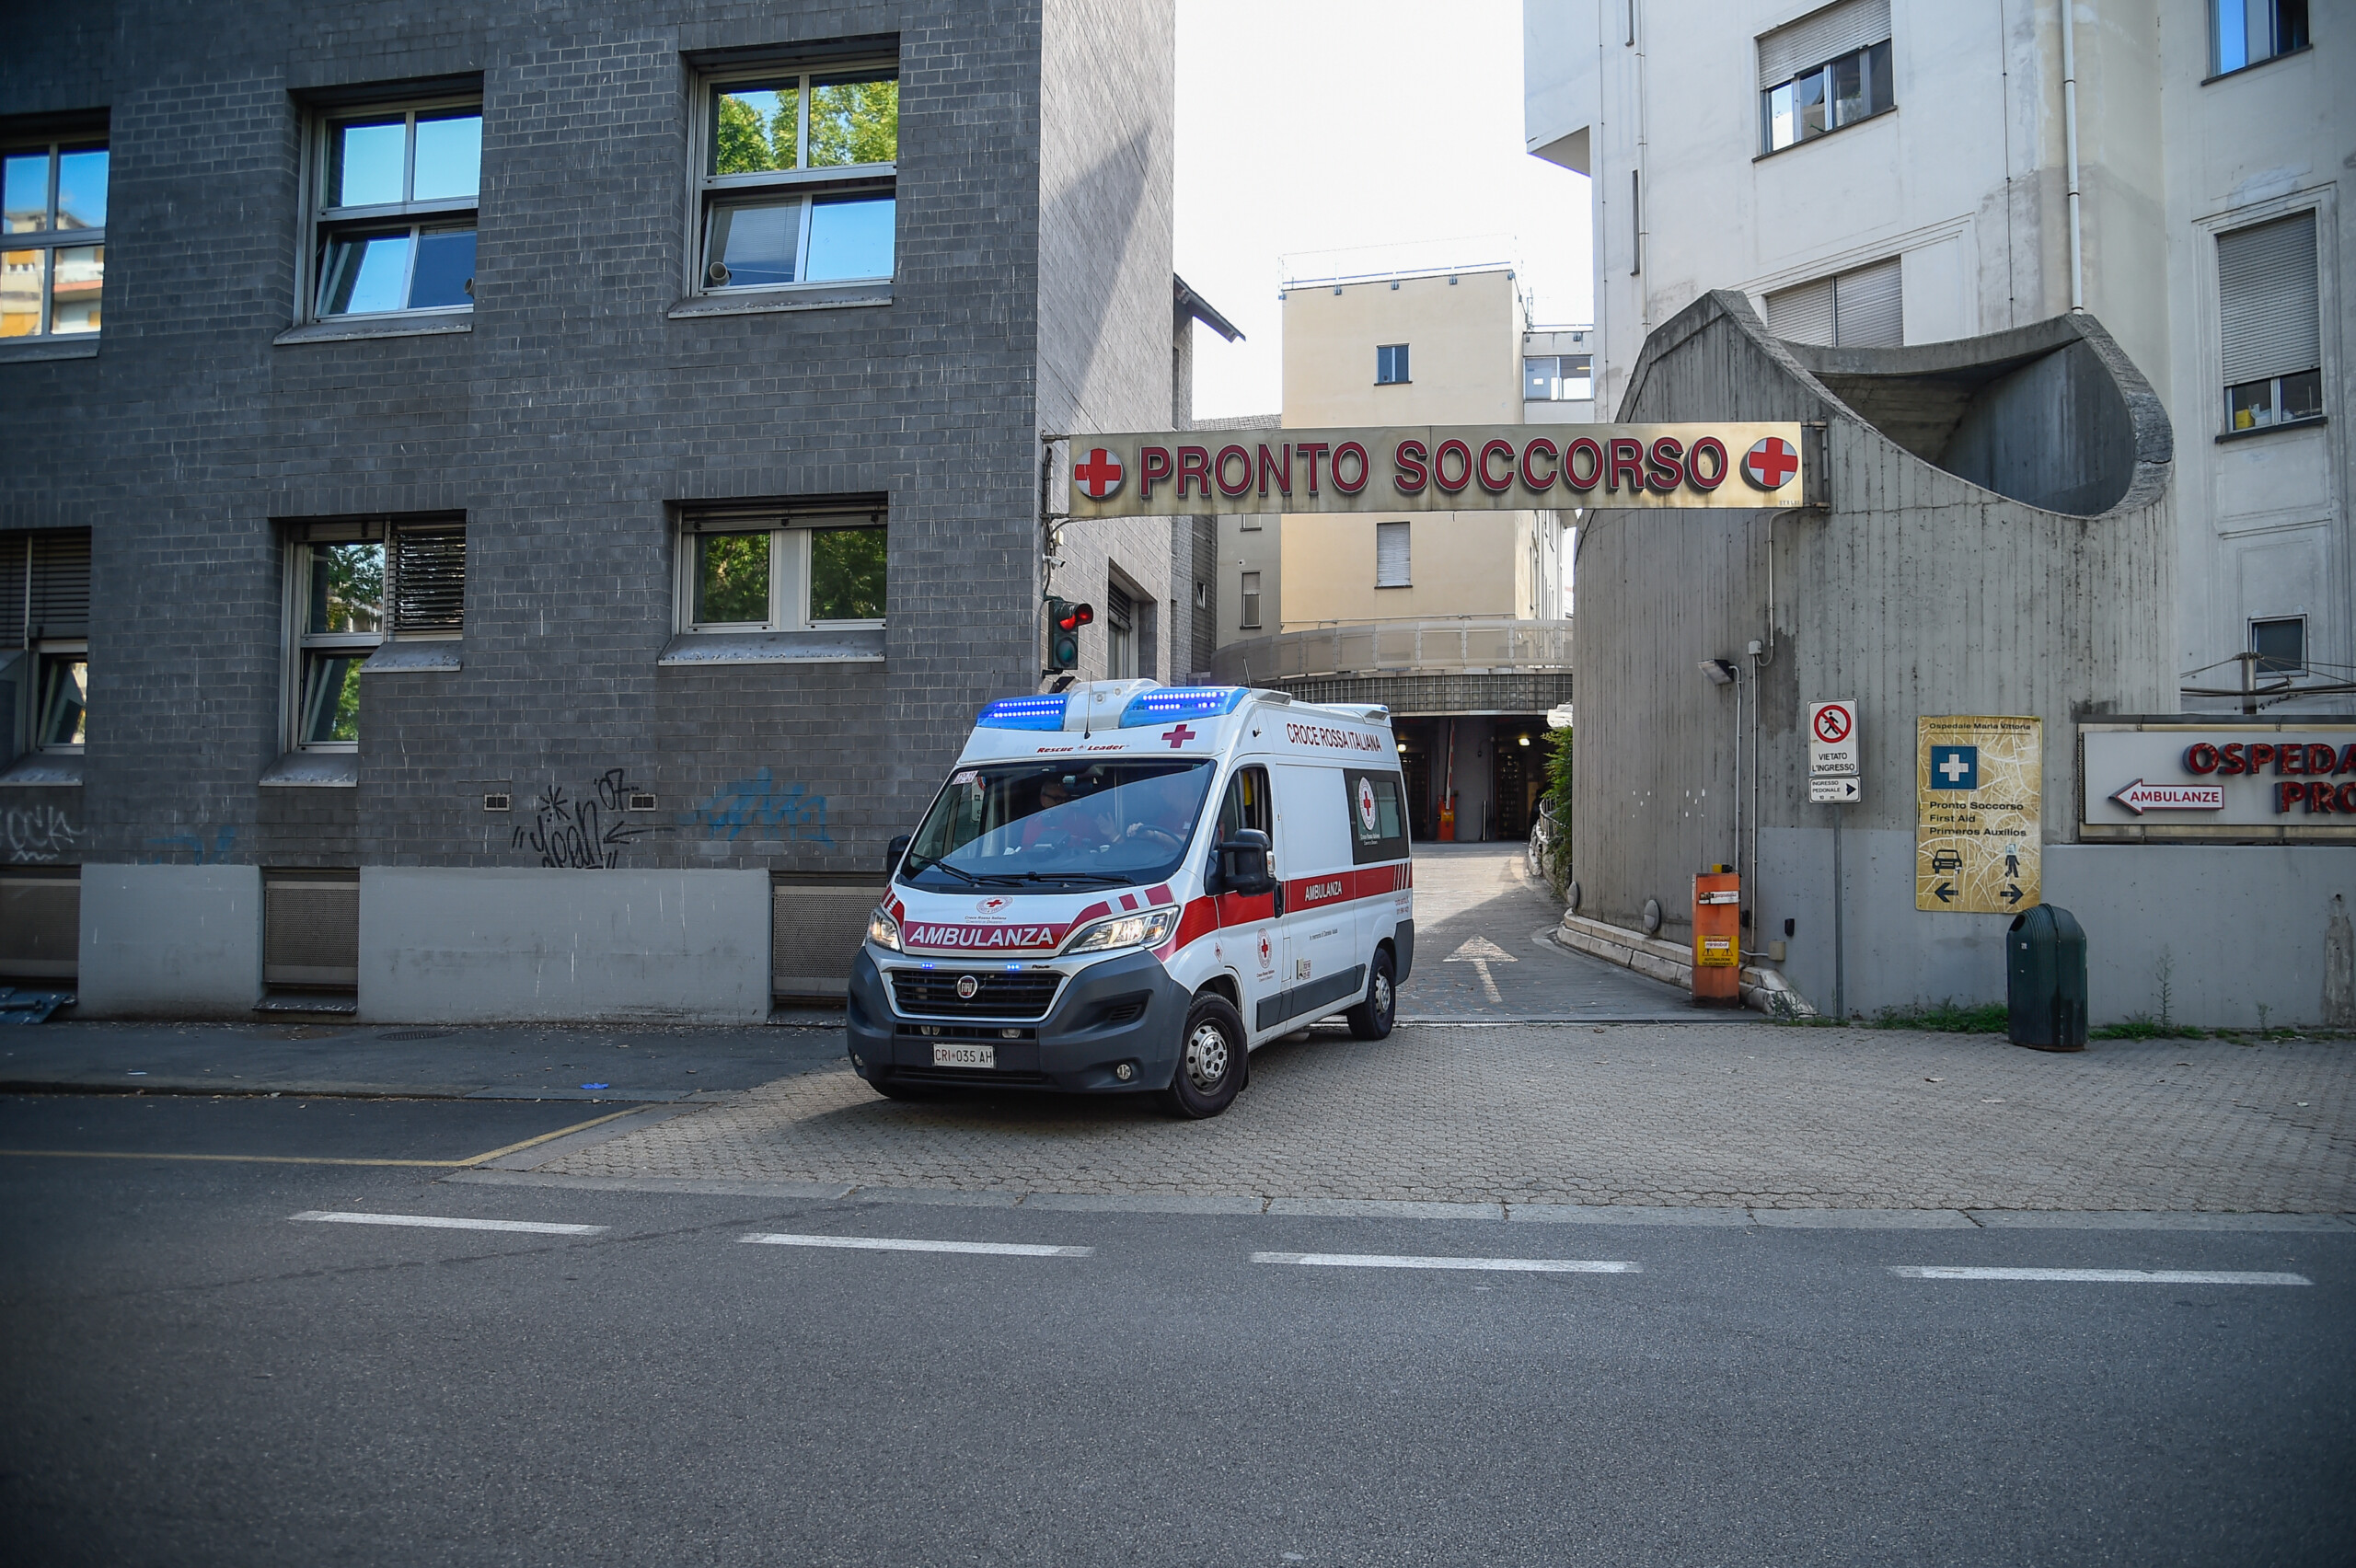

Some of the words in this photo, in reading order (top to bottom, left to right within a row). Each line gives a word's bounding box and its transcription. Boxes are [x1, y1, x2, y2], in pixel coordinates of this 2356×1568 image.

[1139, 440, 1371, 500] PRONTO
[1393, 435, 1729, 493] SOCCORSO
[1929, 722, 1971, 731] Ospedale
[2000, 722, 2031, 731] Vittoria
[1286, 722, 1321, 746] CROCE
[1319, 727, 1350, 749] ROSSA
[1347, 731, 1383, 753] ITALIANA
[1818, 752, 1848, 761] VIETATO
[1811, 763, 1855, 772] L'INGRESSO
[2130, 790, 2220, 802] AMBULANZE
[1929, 801, 1967, 810] Pronto
[1969, 801, 2025, 811] Soccorso
[1929, 813, 1958, 823] First
[1958, 813, 1976, 823] Aid
[1929, 826, 1981, 836] Primeros
[1983, 827, 2027, 836] Auxilios
[1304, 880, 1343, 902] AMBULANZA
[908, 925, 1055, 947] AMBULANZA
[961, 982, 974, 994] FIAT
[935, 1049, 951, 1062] CRI
[956, 1049, 976, 1063] 035
[979, 1051, 992, 1064] AH
